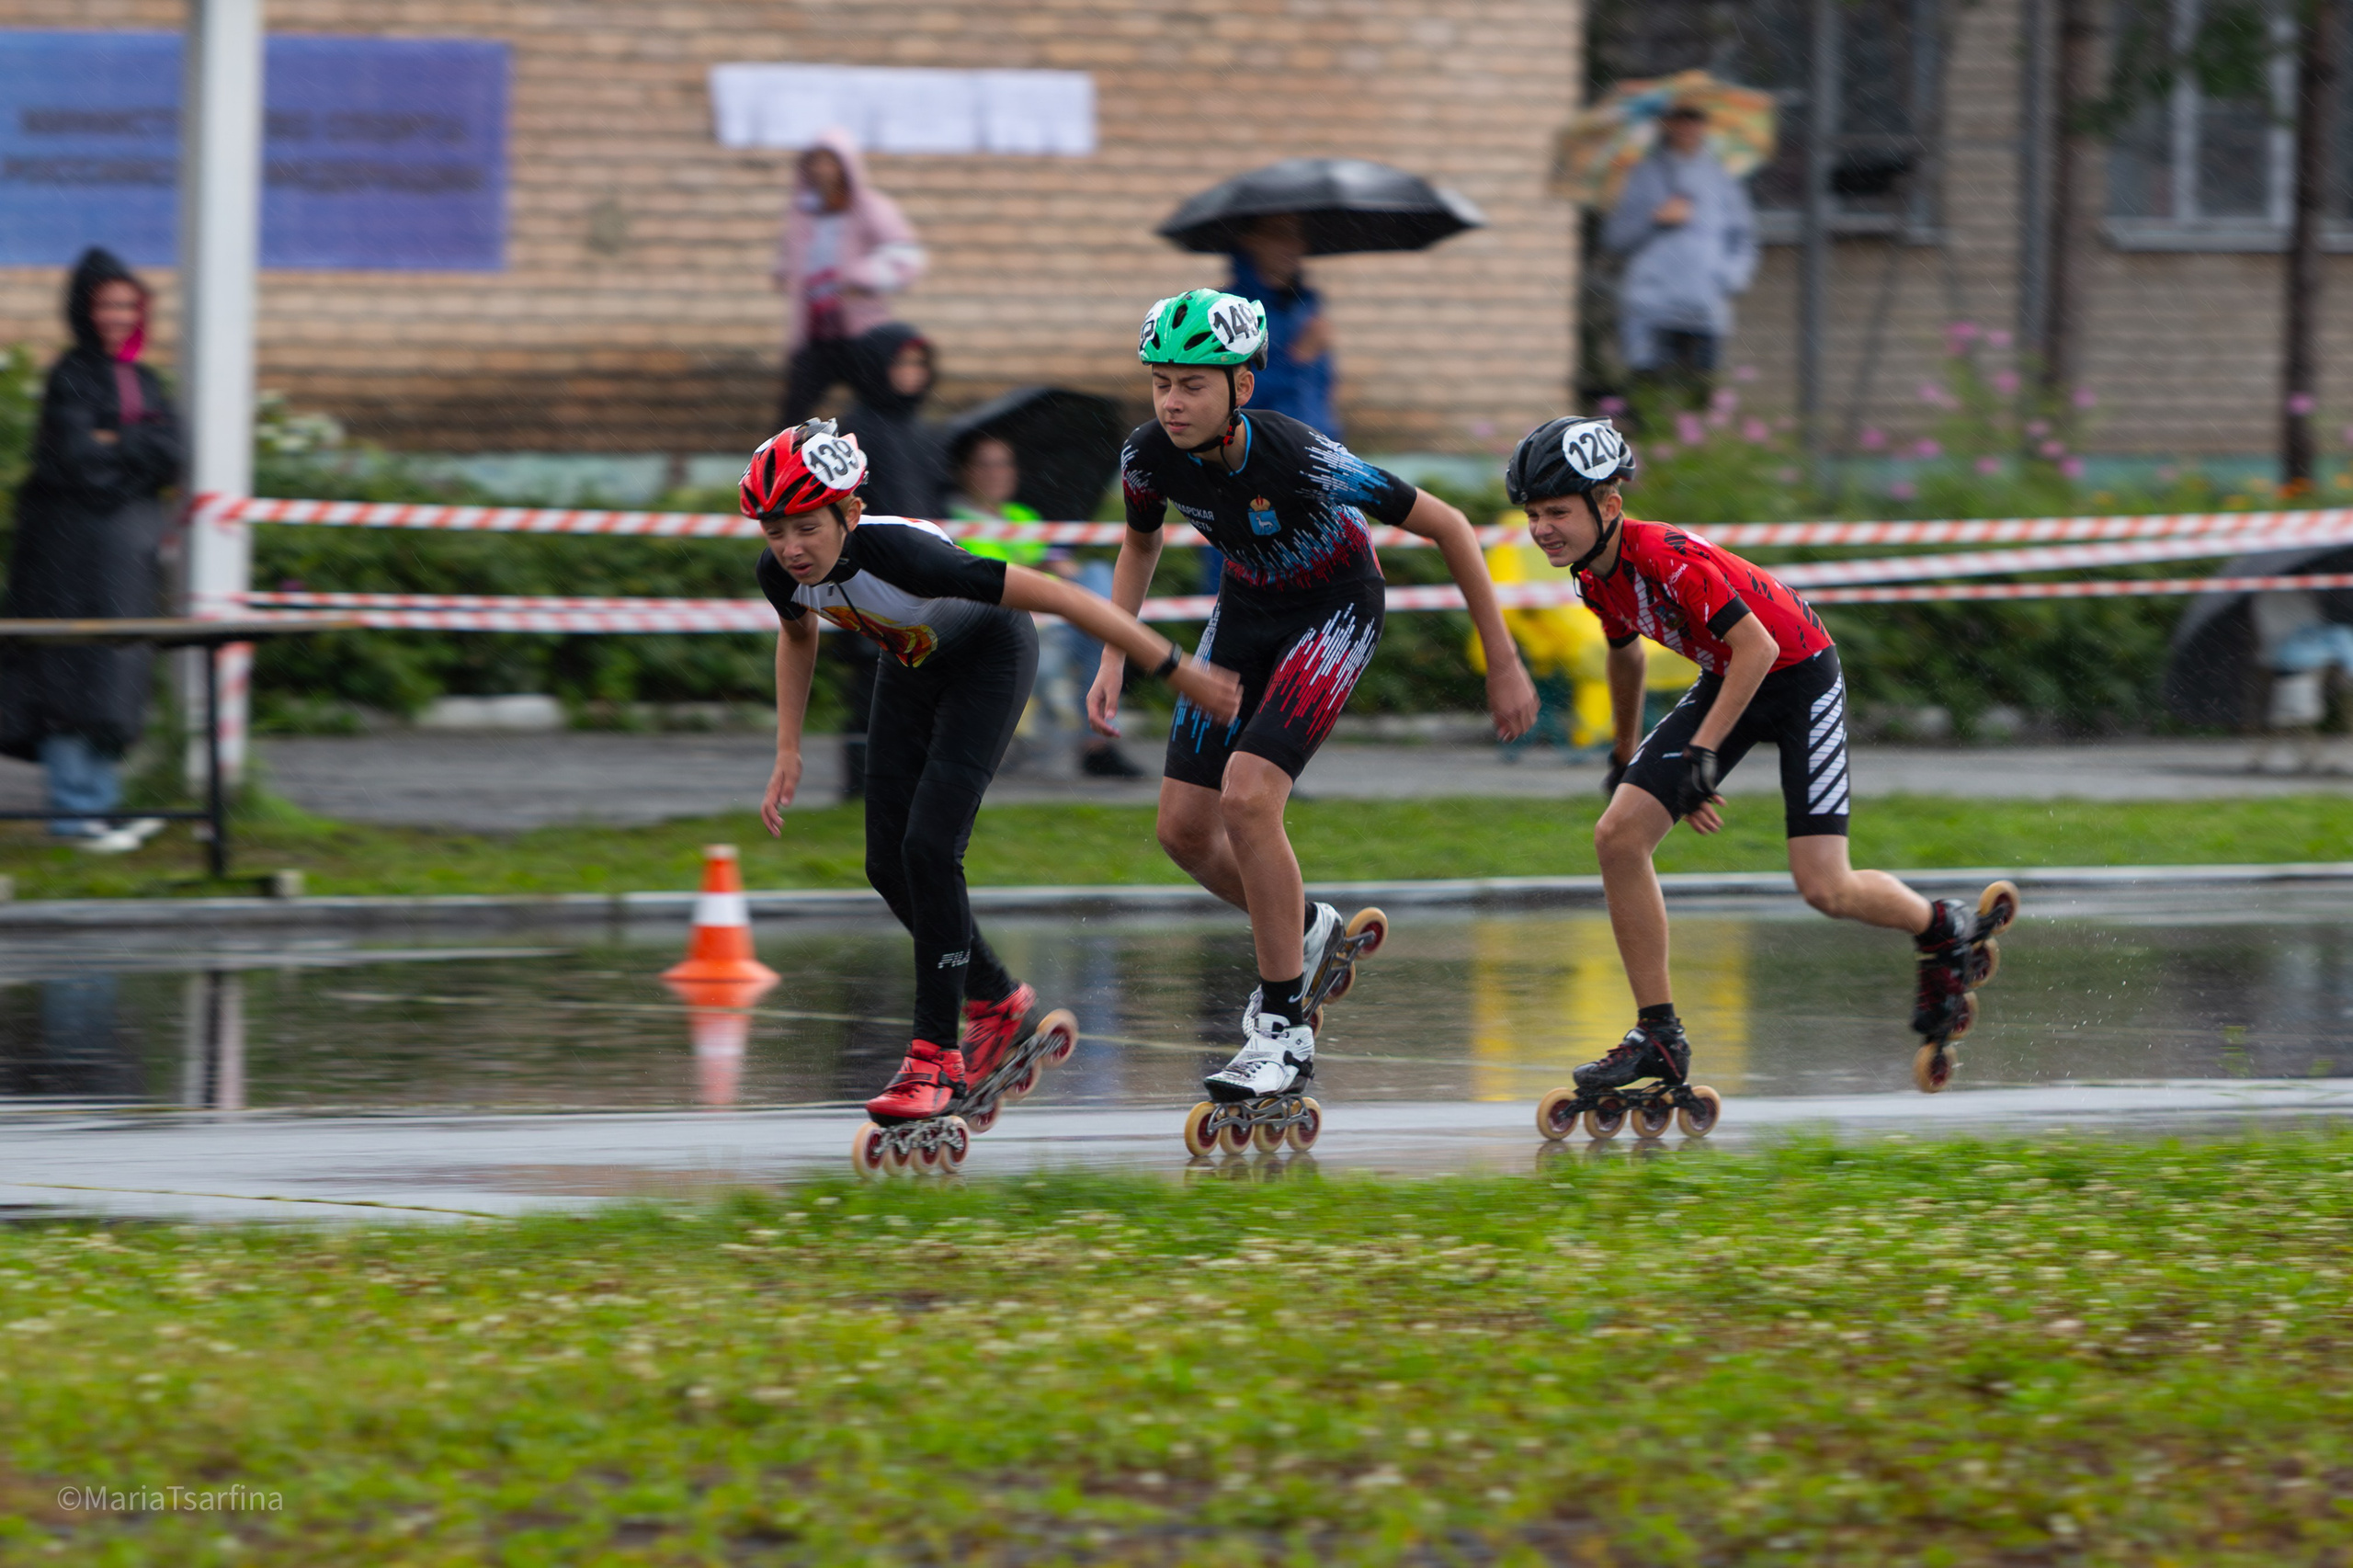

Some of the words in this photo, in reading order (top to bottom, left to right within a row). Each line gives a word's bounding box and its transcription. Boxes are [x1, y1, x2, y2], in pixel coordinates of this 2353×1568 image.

[808, 438, 860, 482] 139
[1569, 426, 1618, 471] 120
[1171, 499, 1215, 521] МАРСКАЯ
